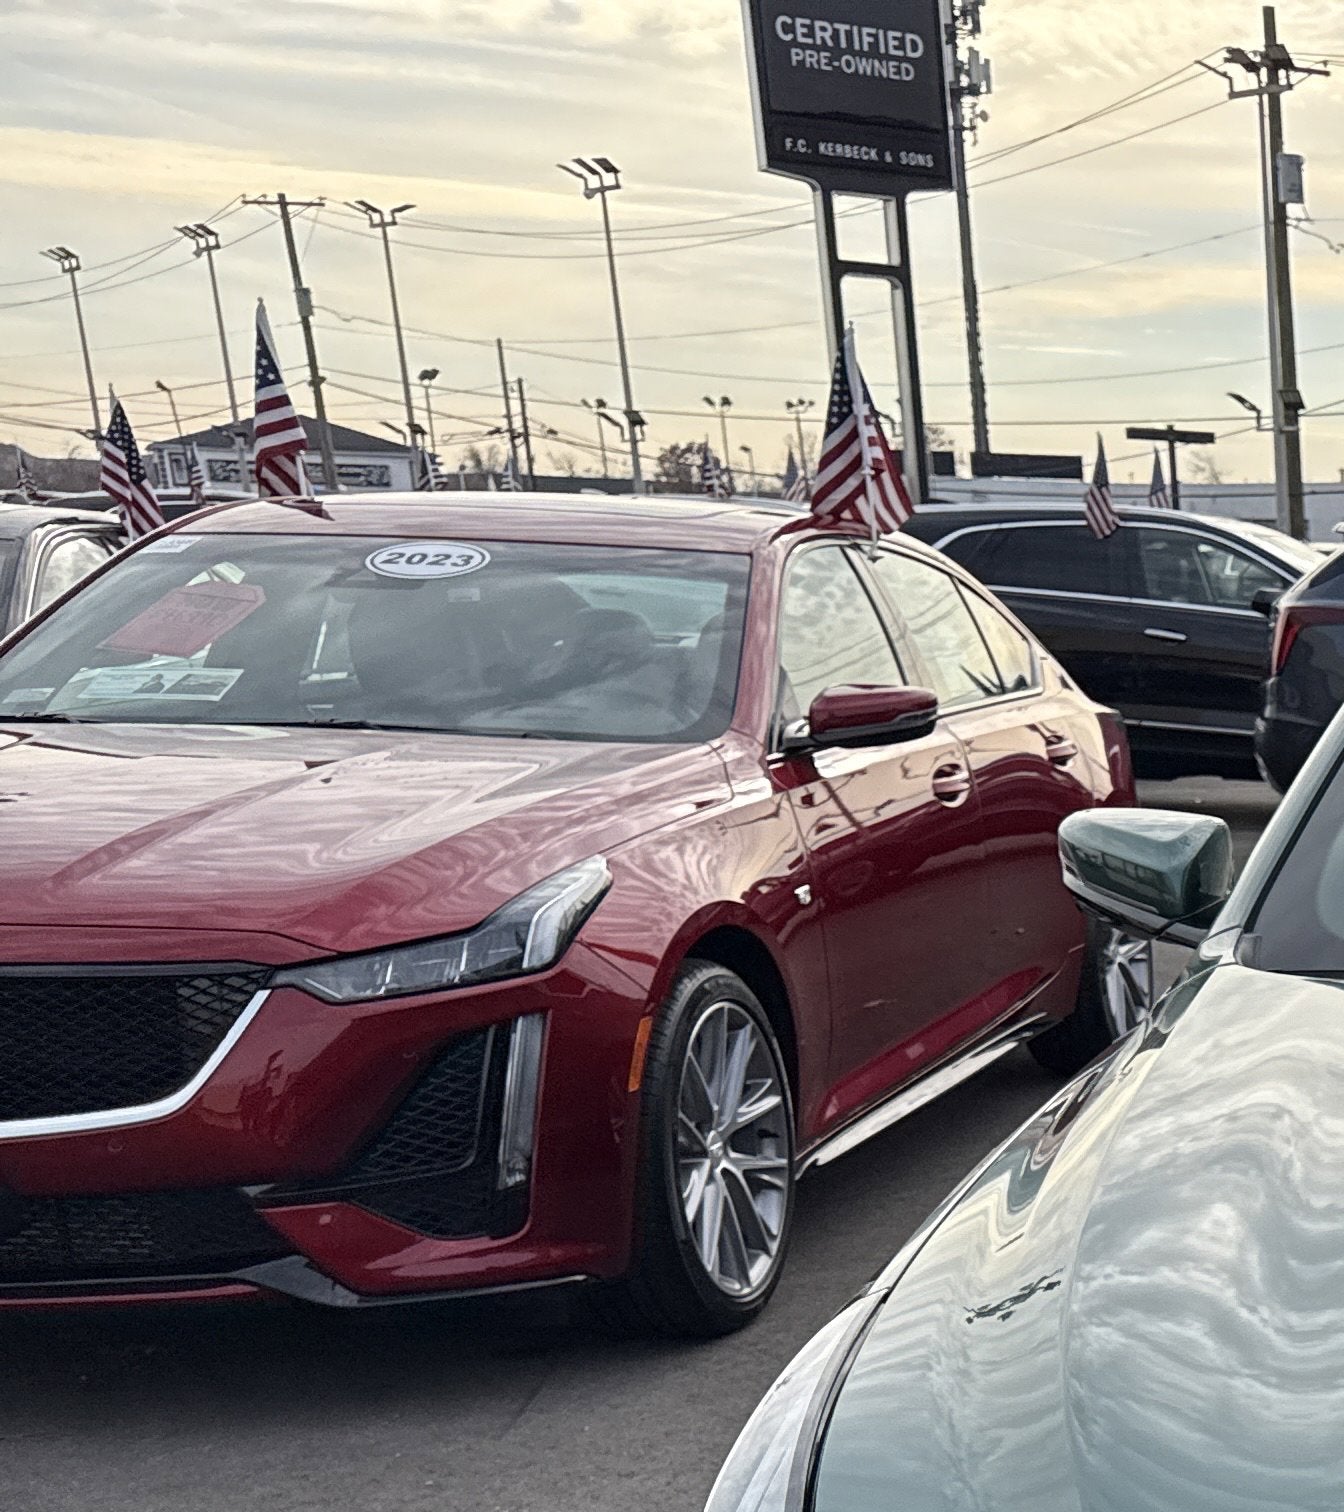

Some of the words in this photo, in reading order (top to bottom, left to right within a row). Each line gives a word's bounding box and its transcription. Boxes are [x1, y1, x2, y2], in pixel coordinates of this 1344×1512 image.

[775, 15, 924, 59] CERTIFIED
[790, 47, 916, 82] PRE-OWNED
[784, 137, 812, 154] F.C.
[818, 141, 879, 162] KERBECK
[884, 151, 893, 163] &
[899, 151, 935, 168] SONS
[379, 552, 474, 568] 2023
